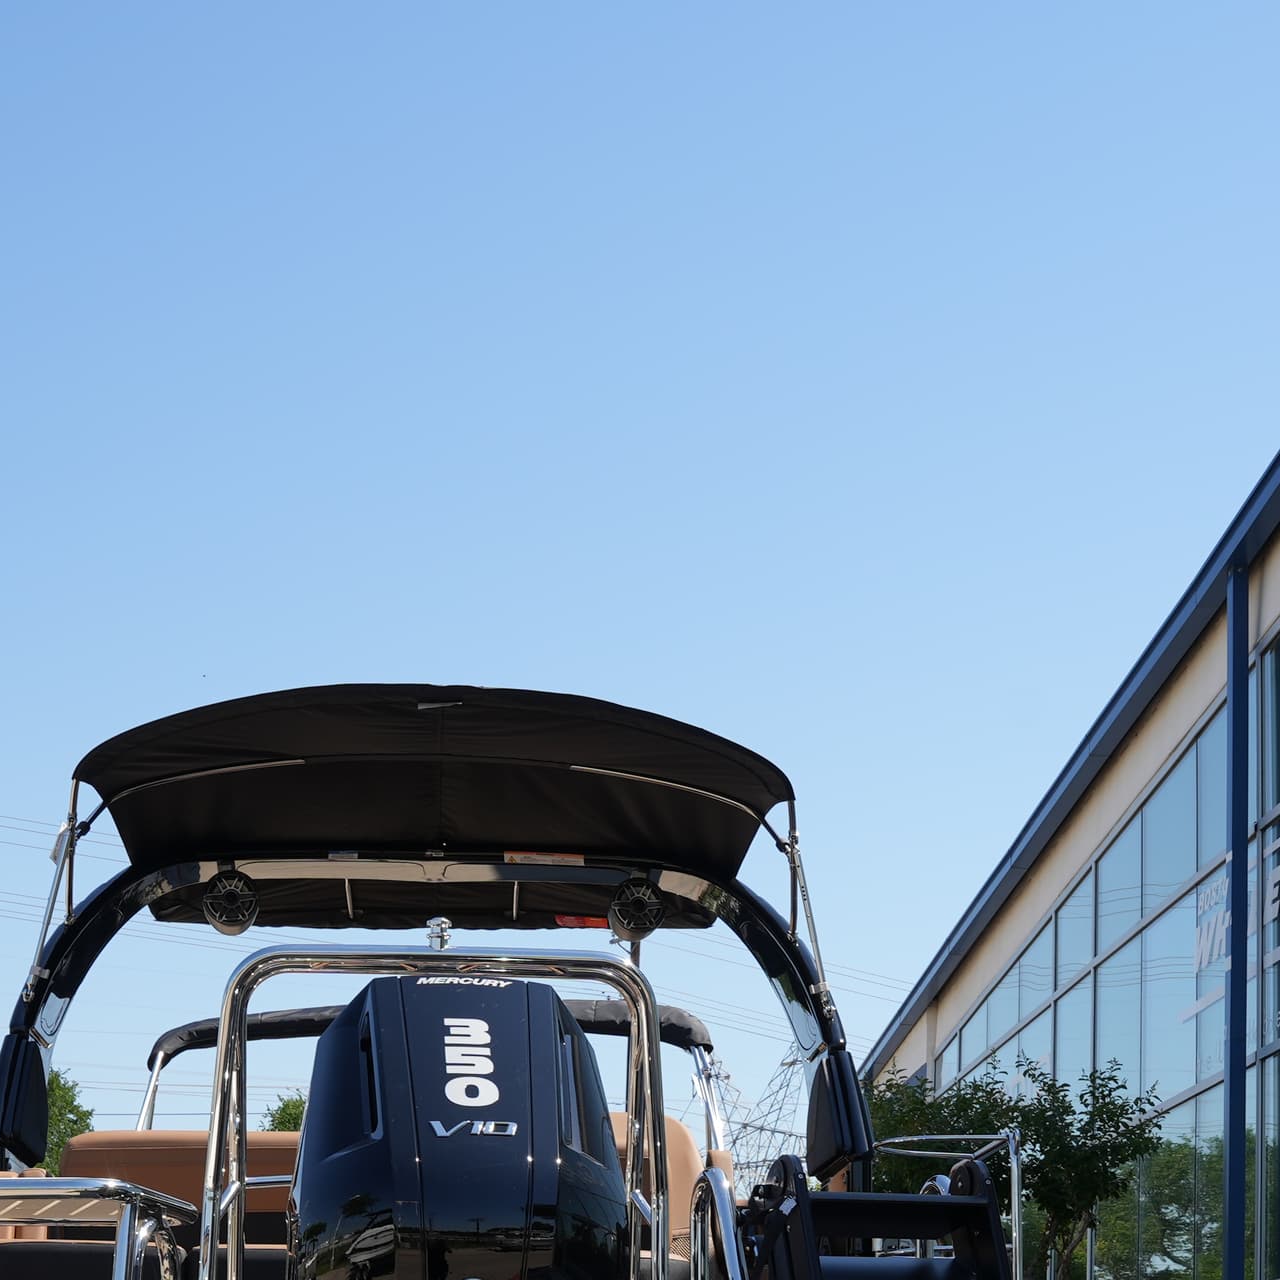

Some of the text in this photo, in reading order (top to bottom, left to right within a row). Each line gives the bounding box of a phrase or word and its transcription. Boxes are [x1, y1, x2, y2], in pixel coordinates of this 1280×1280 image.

[416, 976, 513, 988] MERCURY
[443, 1018, 500, 1107] 350
[429, 1120, 518, 1137] V10
